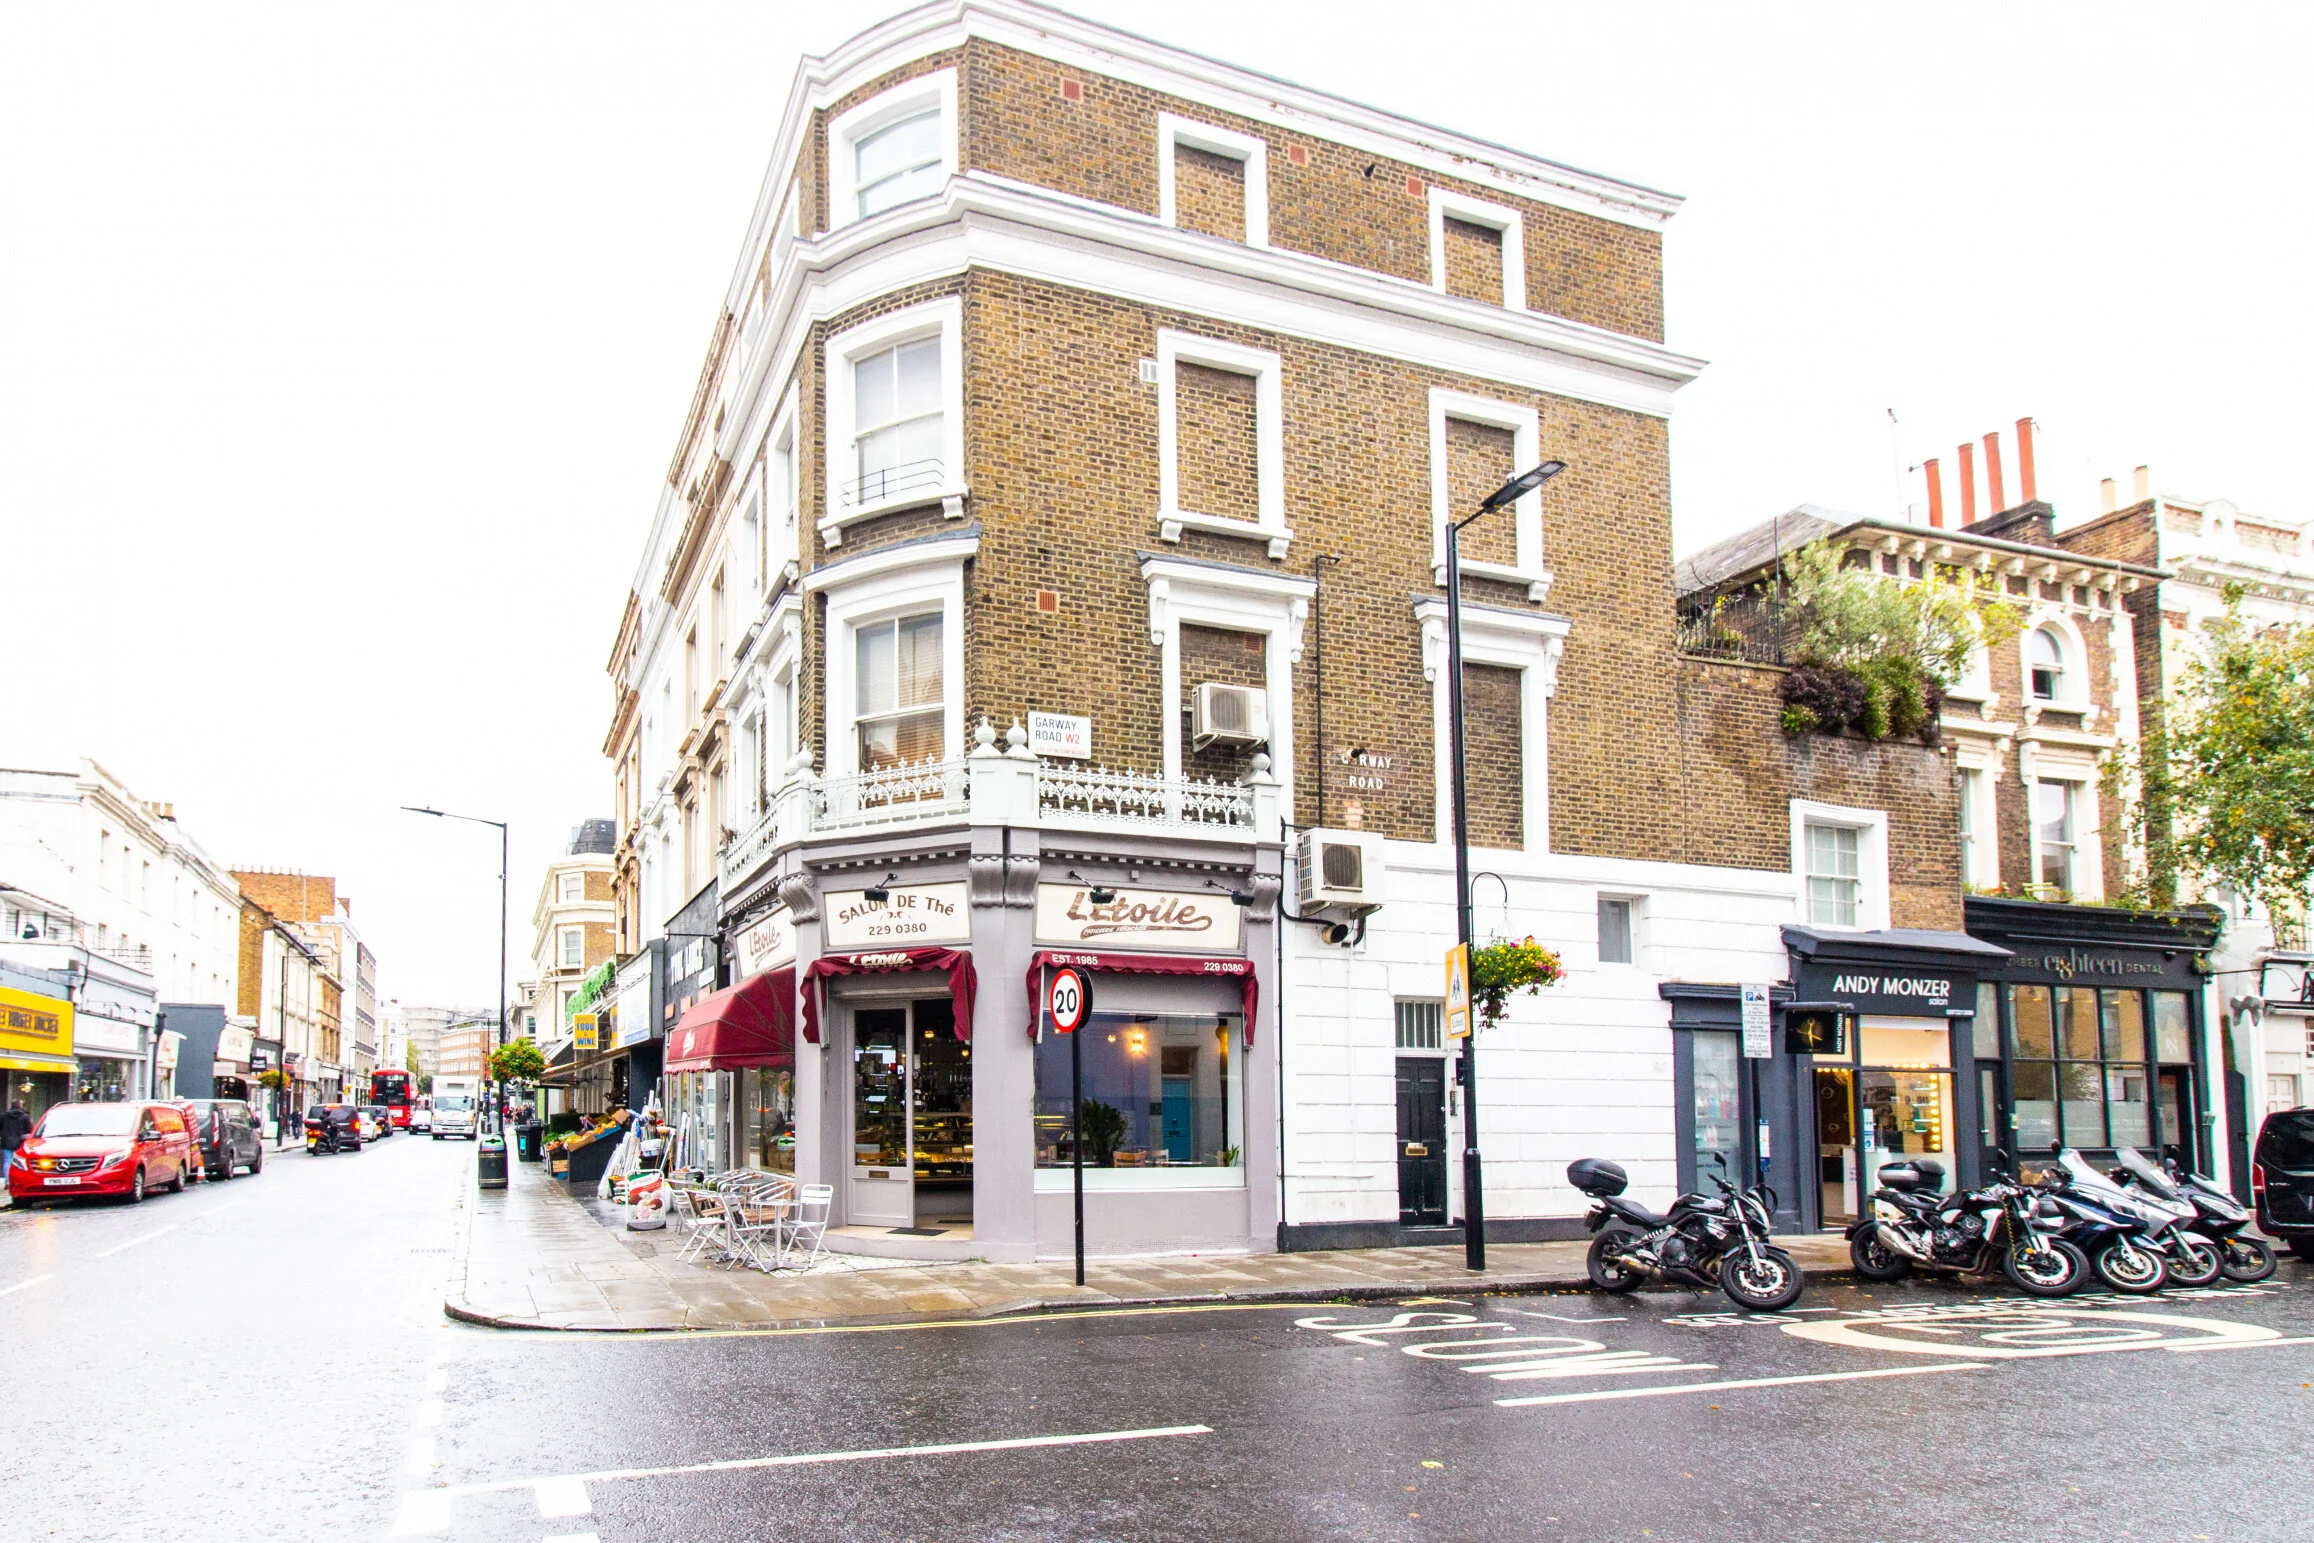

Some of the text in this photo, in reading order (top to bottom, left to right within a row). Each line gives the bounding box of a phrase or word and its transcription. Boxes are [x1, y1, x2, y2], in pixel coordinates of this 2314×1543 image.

[1035, 717, 1077, 731] GARWAY
[1035, 730, 1080, 744] ROAD W2
[1341, 755, 1392, 769] GRWAY
[1349, 775, 1384, 790] ROAD
[897, 895, 918, 908] DE
[868, 923, 927, 936] 229 0380
[1052, 953, 1098, 965] EST. 1985
[2044, 947, 2123, 980] eighteen
[2125, 963, 2165, 975] DENTAL
[1203, 962, 1244, 972] 229 0380
[1832, 975, 1951, 997] ANDY MONZER
[1054, 988, 1077, 1013] 20
[1928, 998, 1948, 1006] salon
[577, 1023, 595, 1031] FOOD
[1836, 1013, 1844, 1037] MONZER
[577, 1038, 595, 1046] WINE
[1882, 1316, 2164, 1345] 20
[1293, 1311, 1721, 1380] SLOW
